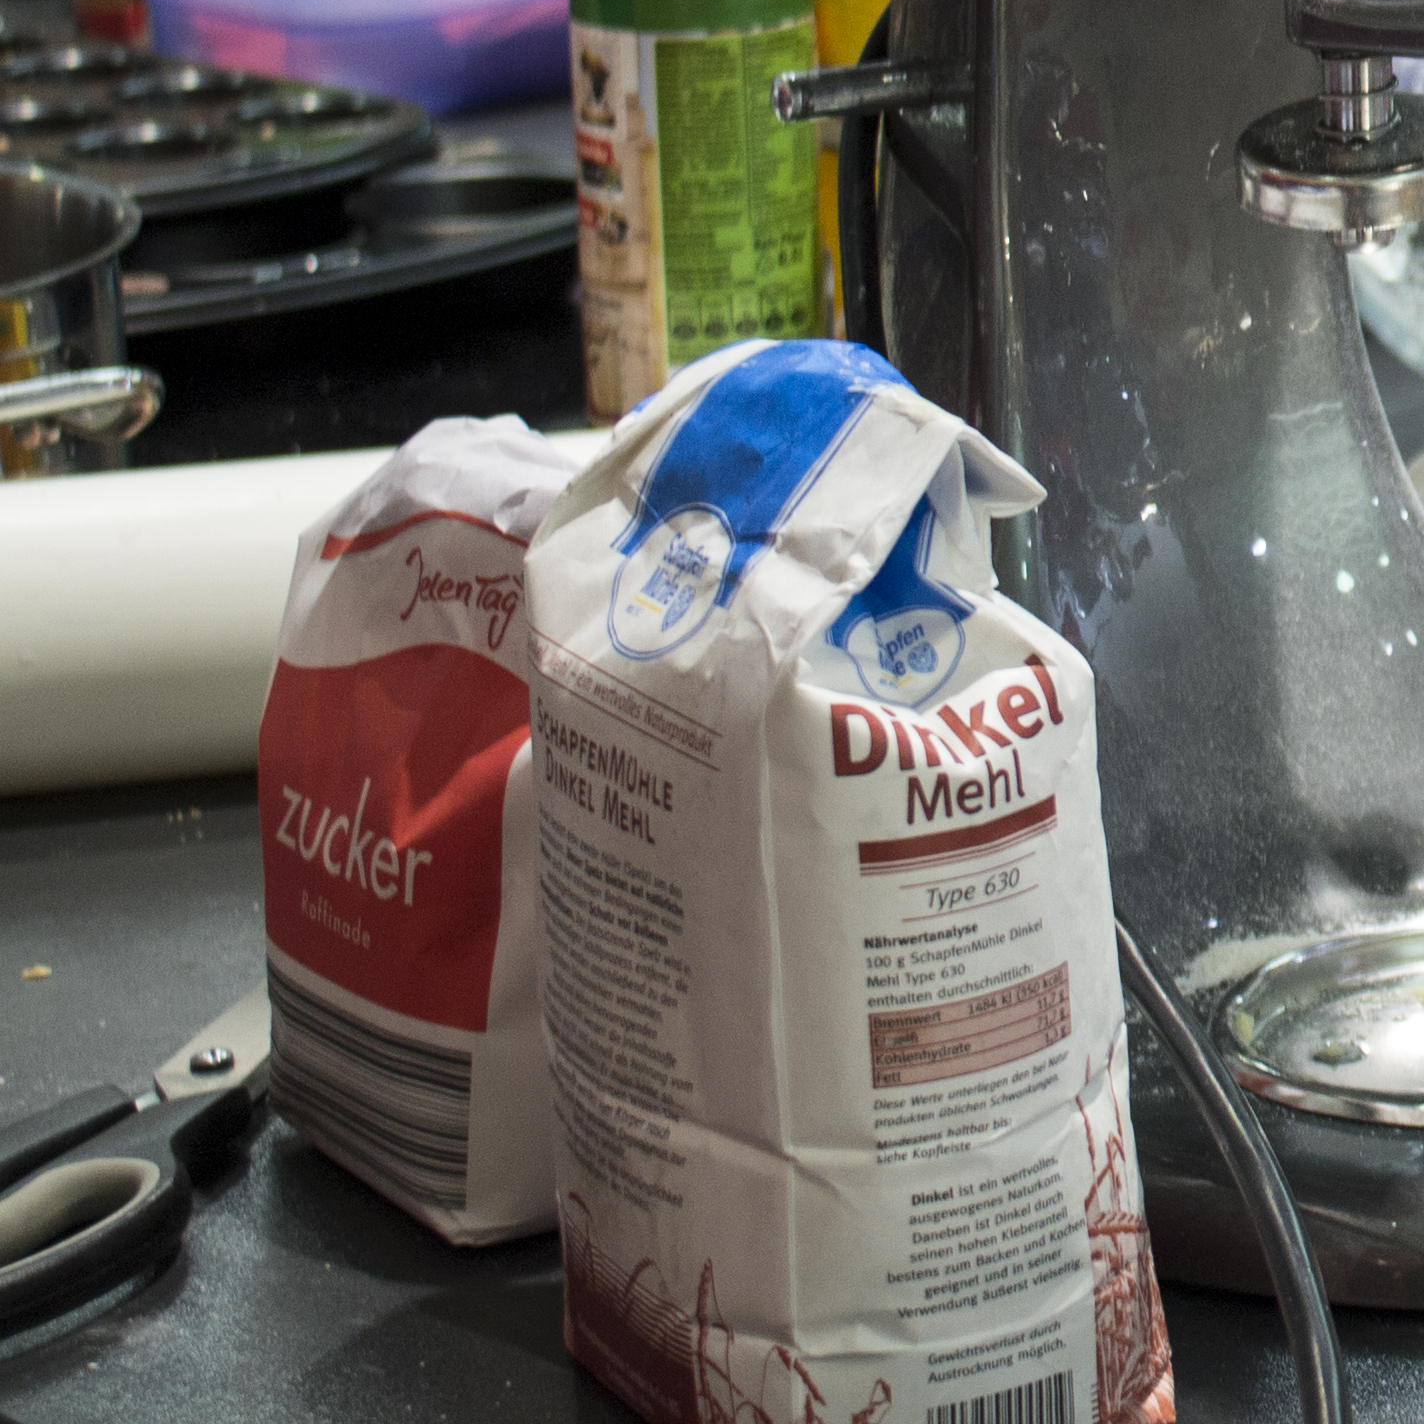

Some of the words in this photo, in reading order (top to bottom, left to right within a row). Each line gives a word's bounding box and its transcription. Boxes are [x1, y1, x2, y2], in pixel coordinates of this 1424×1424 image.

[472, 572, 523, 653] Tag
[829, 653, 1065, 778] Dinkel
[544, 744, 596, 815] DINKEL
[602, 784, 656, 846] MEHL
[904, 747, 1027, 826] Mehl
[274, 776, 433, 907] zucker
[926, 884, 977, 912] Type
[983, 866, 1021, 898] 630
[300, 888, 372, 951] Raffinade
[863, 922, 980, 951] Nährwertanalyse
[866, 956, 892, 970] 100
[897, 956, 906, 971] g
[909, 932, 1006, 966] SchapfenMühle
[1008, 917, 1045, 942] Dinkel
[866, 974, 900, 989] Mehl
[905, 971, 937, 989] Type
[940, 962, 967, 979] 630
[867, 990, 933, 1009] enthalten
[873, 1010, 942, 1031] Brennwert
[874, 1041, 973, 1067] Kohlenhydrate
[873, 1097, 907, 1112] Diese
[910, 1093, 945, 1108] Werte
[946, 1077, 1010, 1101] unterliegen
[1011, 1068, 1031, 1084] den
[1032, 1063, 1047, 1077] bei
[873, 1110, 936, 1130] produkten
[938, 1099, 987, 1118] üblichen
[875, 1130, 943, 1151] Mindestens
[946, 1121, 990, 1138] haltbar
[875, 1150, 908, 1166] siehe
[912, 1139, 972, 1160] Kopfleiste
[908, 1194, 1004, 1226] ausgewogenes
[911, 1186, 955, 1208] Dinkel
[958, 1183, 975, 1198] ist
[978, 1177, 999, 1193] ein
[909, 1245, 954, 1264] seinen
[957, 1234, 998, 1254] hohen
[1000, 1205, 1069, 1243] Kleberanteil
[911, 1224, 972, 1245] Daneben
[975, 1216, 991, 1231] ist
[994, 1202, 1032, 1227] Dinkel
[1033, 1189, 1065, 1213] durch
[886, 1266, 941, 1286] bestens
[943, 1259, 972, 1277] zum
[975, 1244, 1021, 1268] Backen
[1022, 1236, 1047, 1254] und
[1048, 1216, 1087, 1244] Kochen
[923, 1277, 980, 1301] geeignet
[983, 1266, 1009, 1284] und
[1012, 1261, 1025, 1275] in
[1027, 1247, 1063, 1269] seiner
[897, 1292, 979, 1320] Verwendung
[981, 1279, 1030, 1302] äußerst
[927, 1332, 1026, 1367] Gewichtsverlust
[1028, 1319, 1062, 1341] durch
[926, 1353, 1015, 1385] Austrocknung
